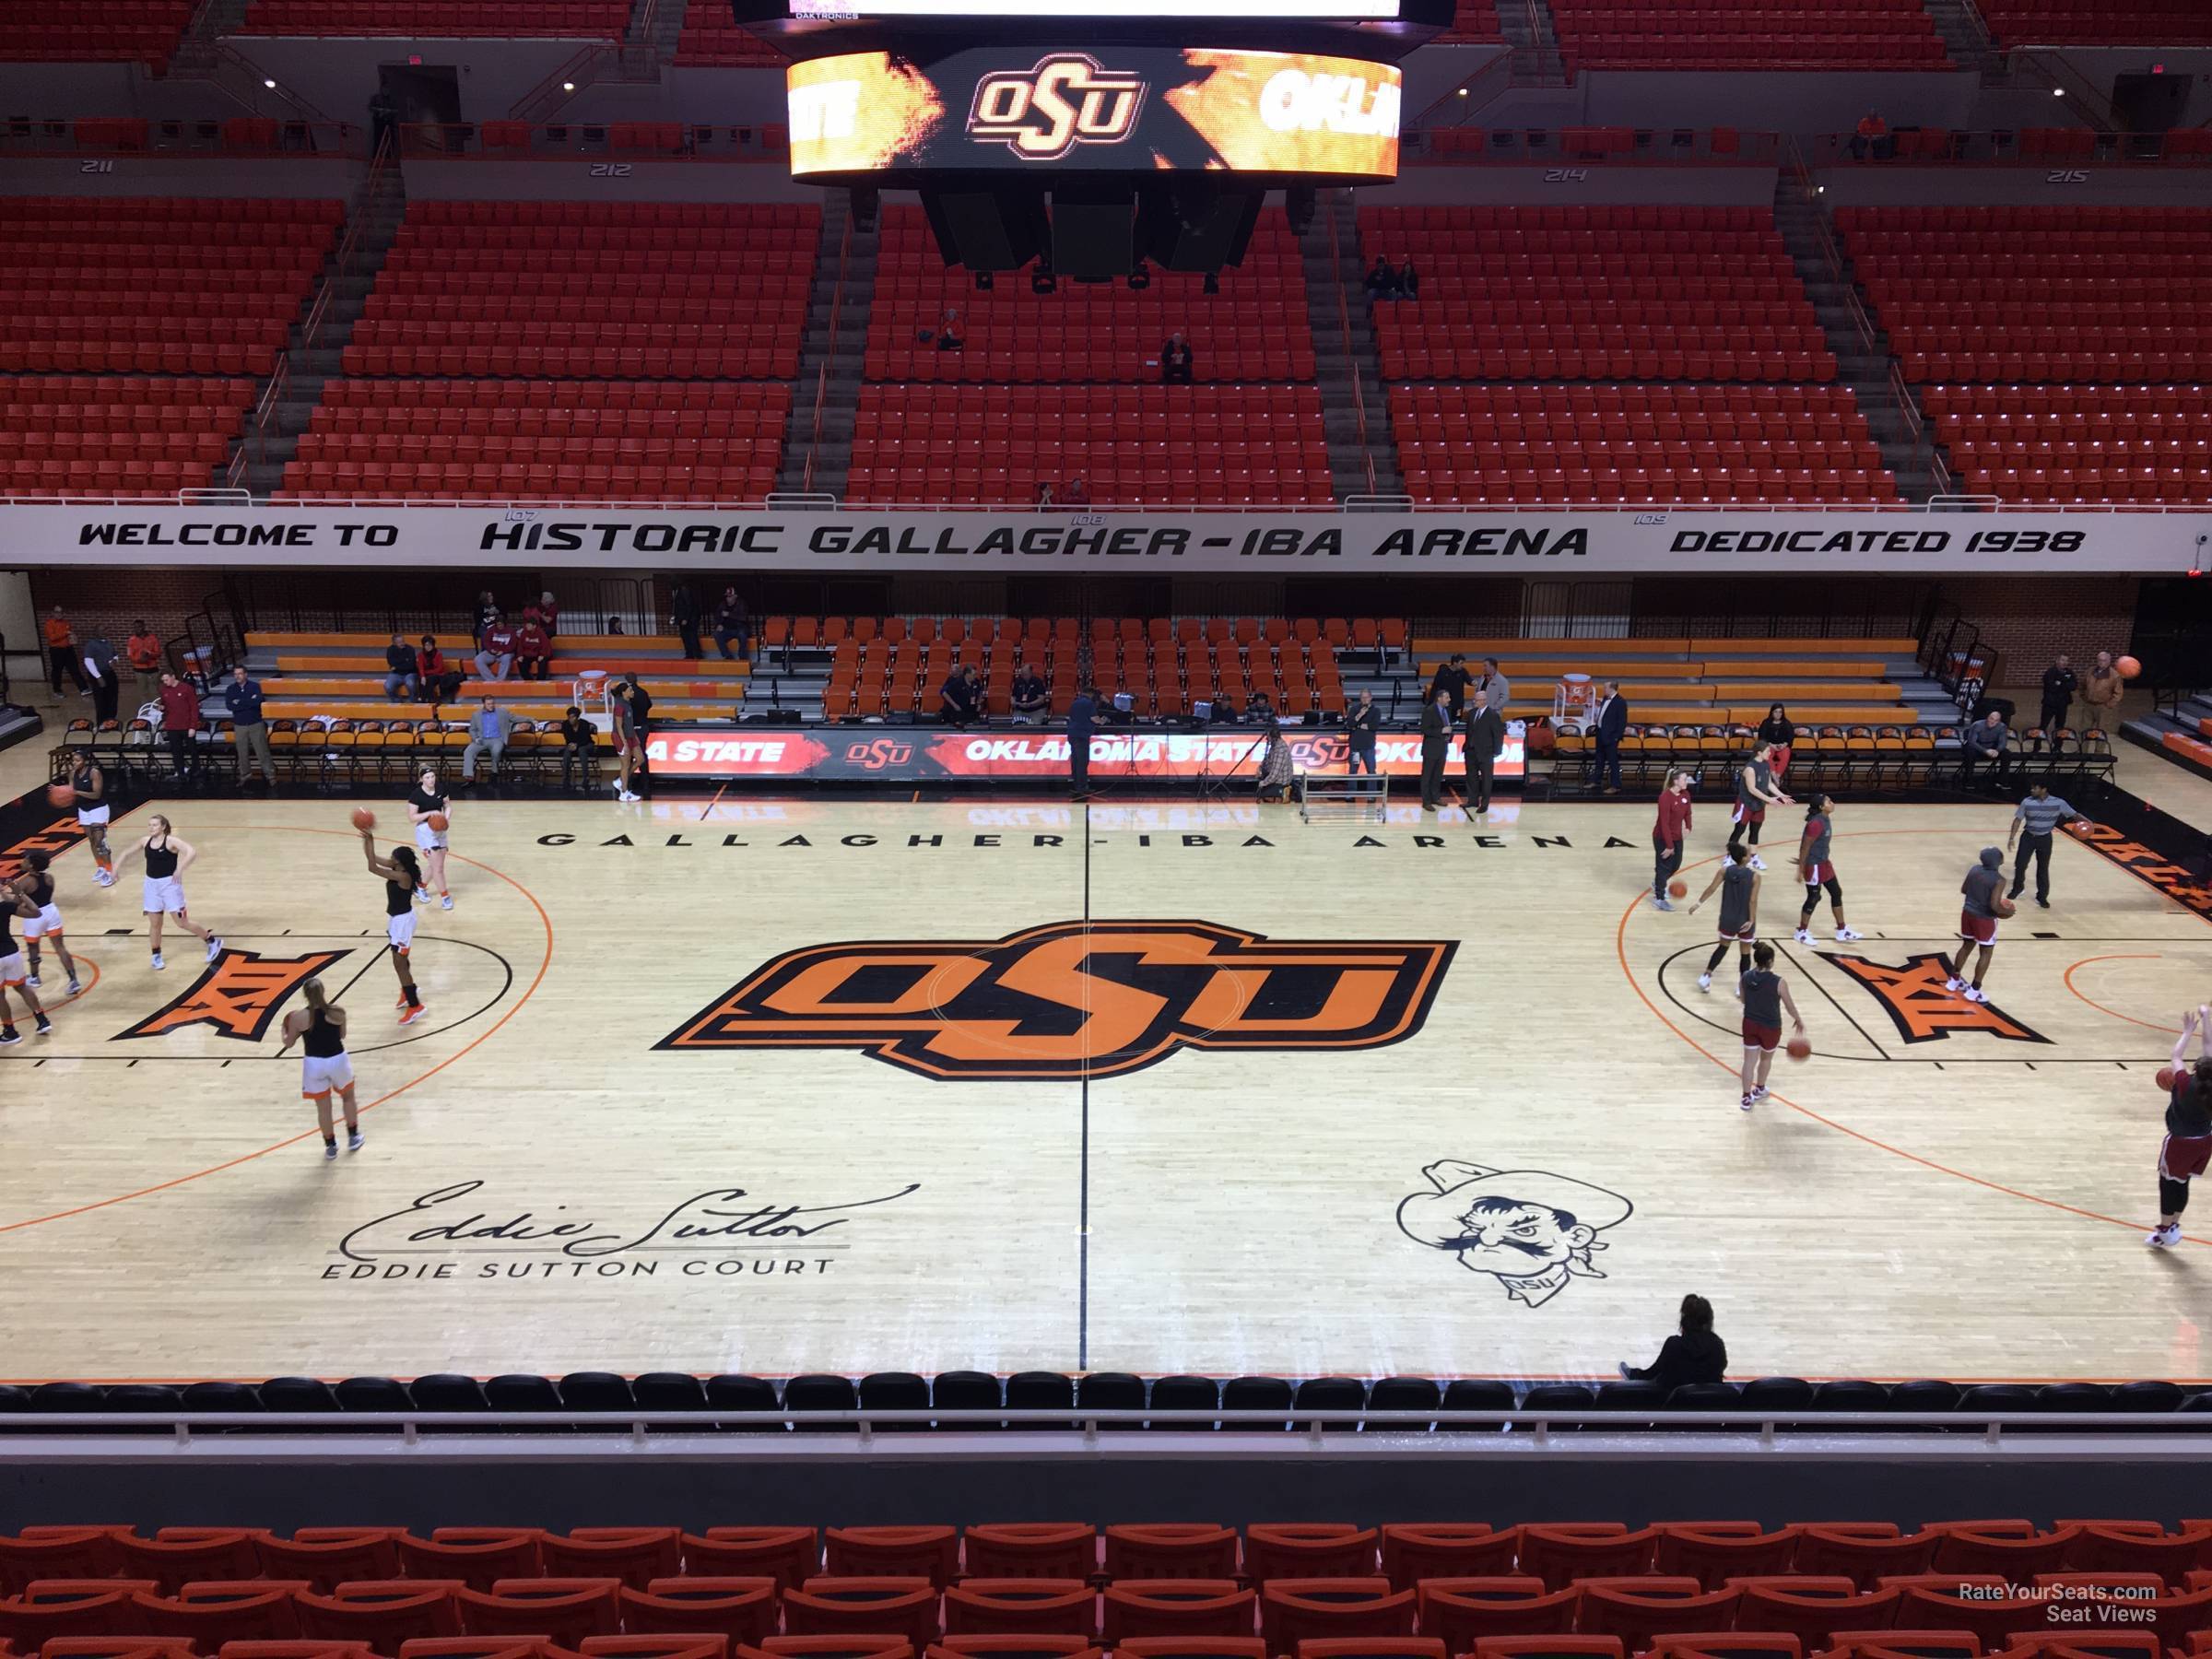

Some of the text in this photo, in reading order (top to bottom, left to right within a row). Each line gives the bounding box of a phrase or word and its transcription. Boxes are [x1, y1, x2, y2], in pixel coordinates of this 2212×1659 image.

[968, 56, 1147, 155] OSU
[80, 160, 112, 173] 211
[590, 163, 631, 177] 212
[1544, 169, 1588, 182] 214
[2046, 170, 2090, 183] 215
[505, 511, 539, 522] 107
[1071, 515, 1106, 525] 108
[79, 524, 317, 546] WELCOME
[333, 524, 399, 547] TO
[479, 523, 784, 553] HISTORIC
[1371, 528, 1588, 556] ARENA
[1670, 530, 1950, 553] DEDICATED
[1964, 531, 2087, 553] 1938
[674, 740, 785, 762] STATE
[844, 738, 915, 770] OSU
[1353, 834, 1639, 848] ARENA
[665, 924, 1447, 1077] OSU
[340, 1180, 920, 1261] Eddie Sutton
[321, 1259, 837, 1279] EDDIE SUTTON COURT
